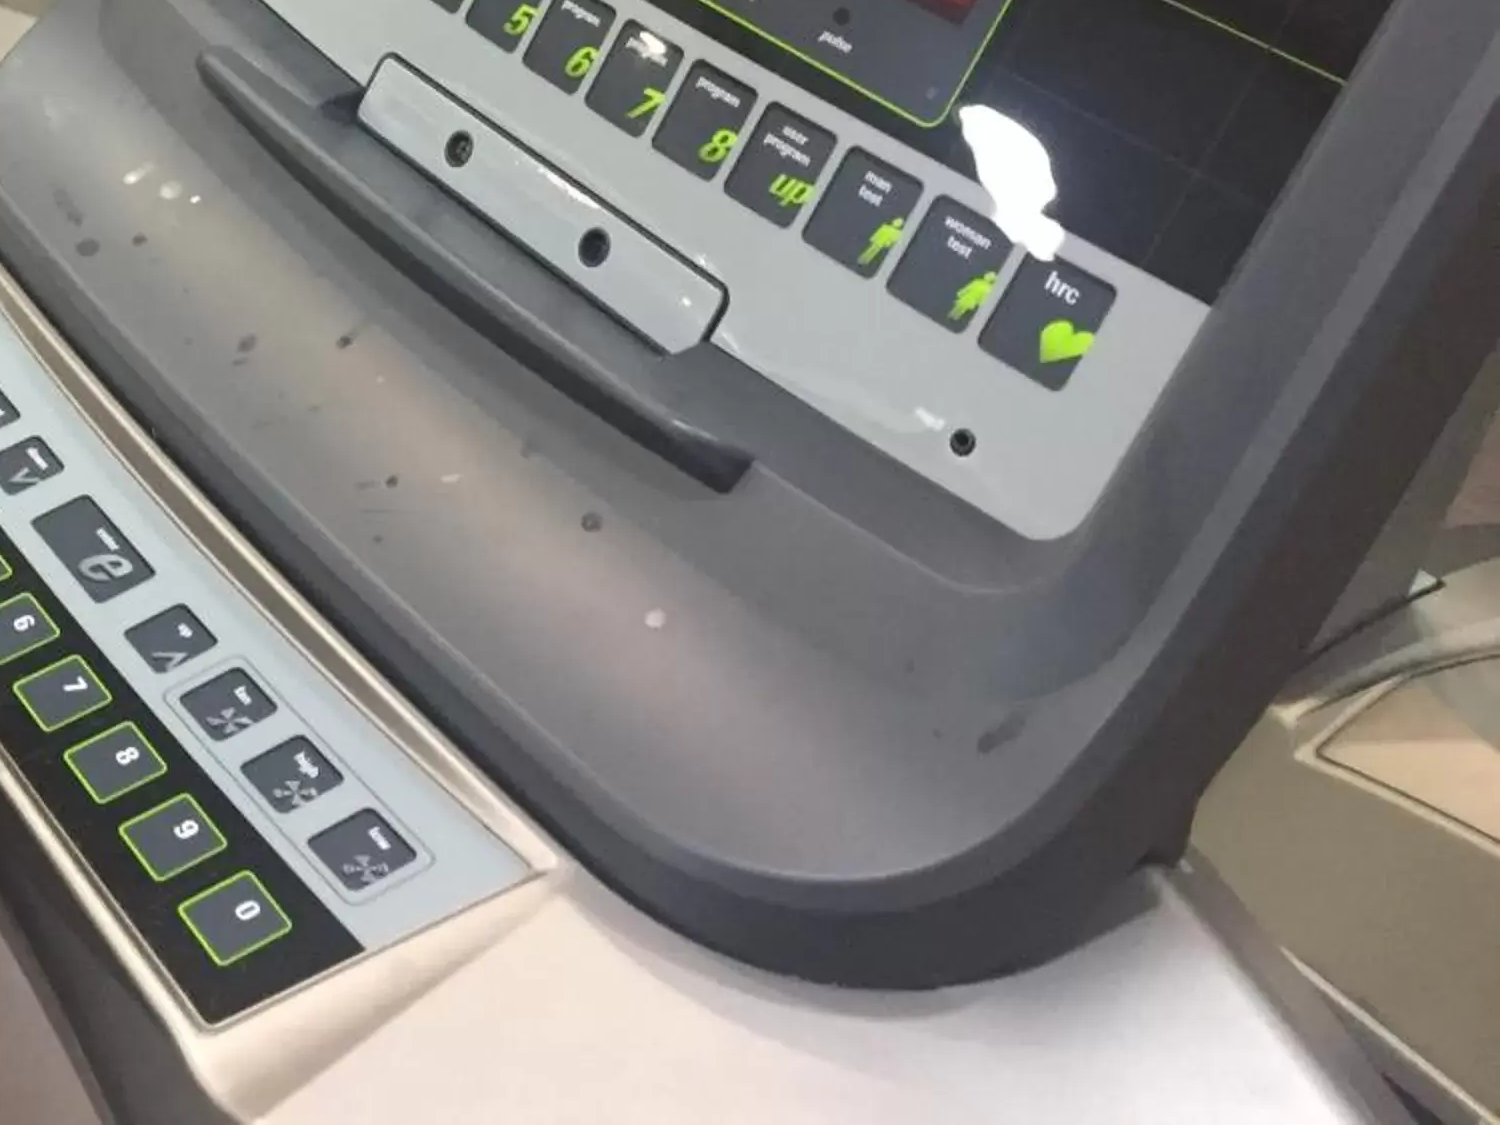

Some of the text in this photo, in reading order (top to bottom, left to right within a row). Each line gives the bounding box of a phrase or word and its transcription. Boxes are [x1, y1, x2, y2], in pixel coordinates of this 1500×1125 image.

[503, 3, 540, 36] 5
[561, 0, 601, 27] program
[818, 30, 853, 54] pulse
[565, 46, 602, 78] 6
[626, 87, 667, 119] 7
[695, 76, 741, 108] program
[698, 128, 739, 163] 8
[763, 132, 811, 167] program
[769, 174, 817, 207] up
[858, 184, 884, 207] test
[864, 170, 893, 195] man
[944, 215, 992, 250] woman
[947, 236, 973, 260] test
[1043, 271, 1081, 306] hrc
[13, 614, 35, 632] 6
[62, 676, 88, 694] 7
[233, 685, 252, 706] fan
[115, 746, 140, 765] 8
[293, 750, 319, 779] high
[173, 819, 199, 839] 9
[235, 900, 261, 921] 0
